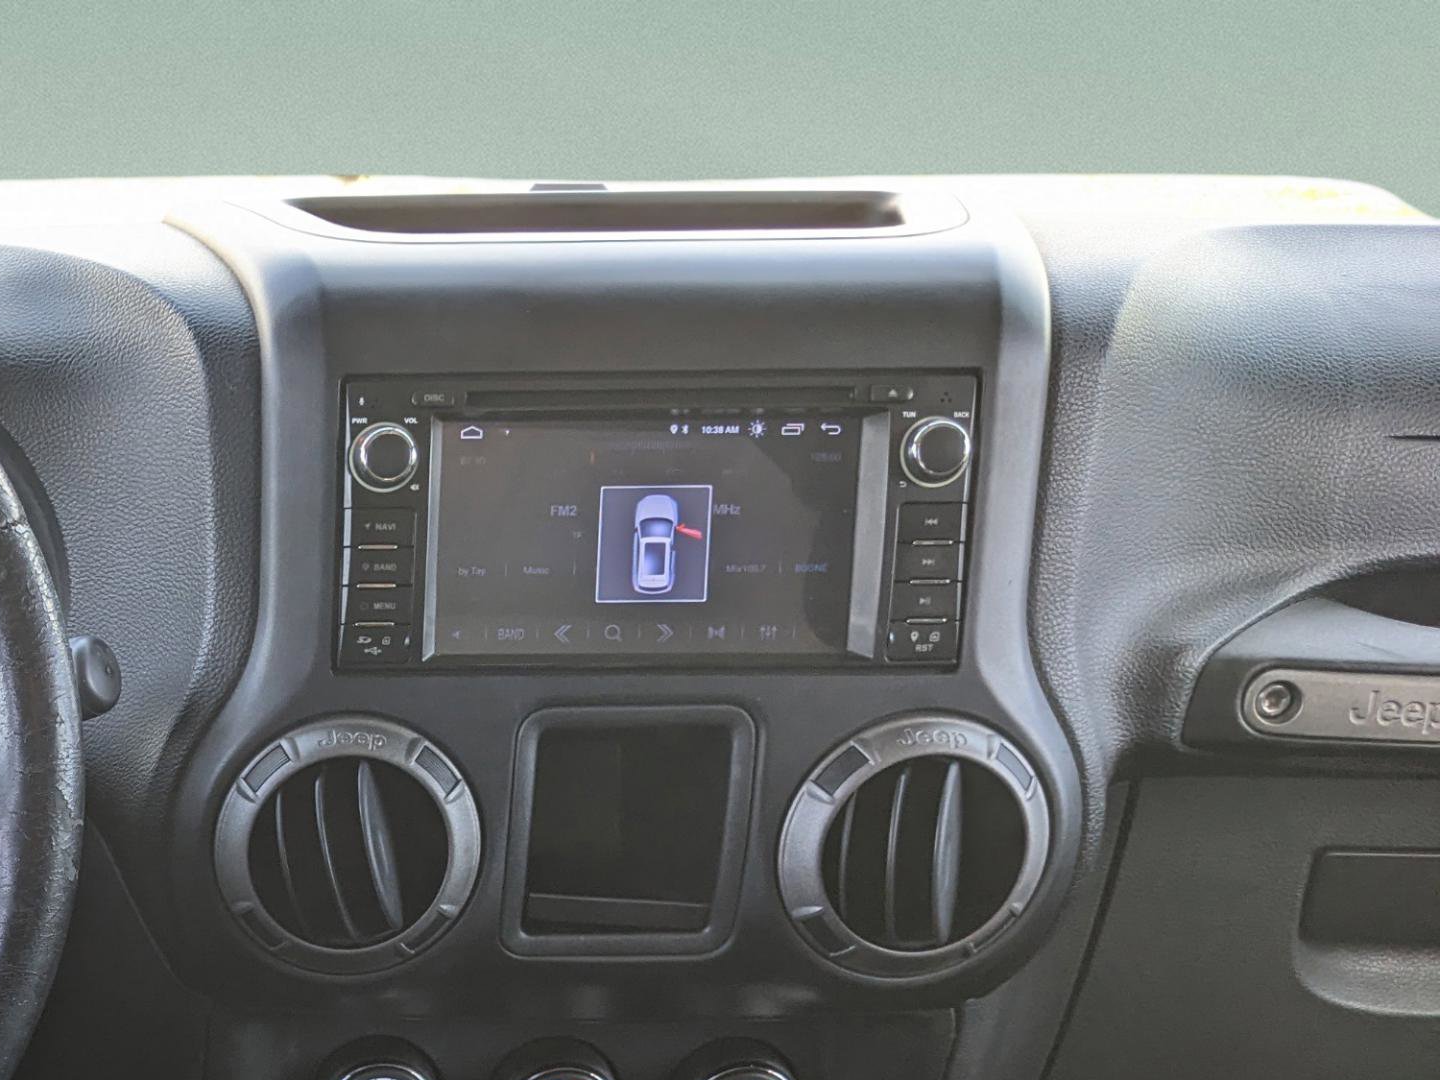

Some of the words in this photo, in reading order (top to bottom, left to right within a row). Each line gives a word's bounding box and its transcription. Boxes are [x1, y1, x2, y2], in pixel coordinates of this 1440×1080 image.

[424, 394, 445, 402] DISC
[725, 426, 739, 434] AM
[550, 505, 577, 517] FM2
[713, 503, 741, 515] MHz
[373, 602, 397, 610] MENU
[498, 628, 524, 641] BAND
[915, 643, 934, 652] RST
